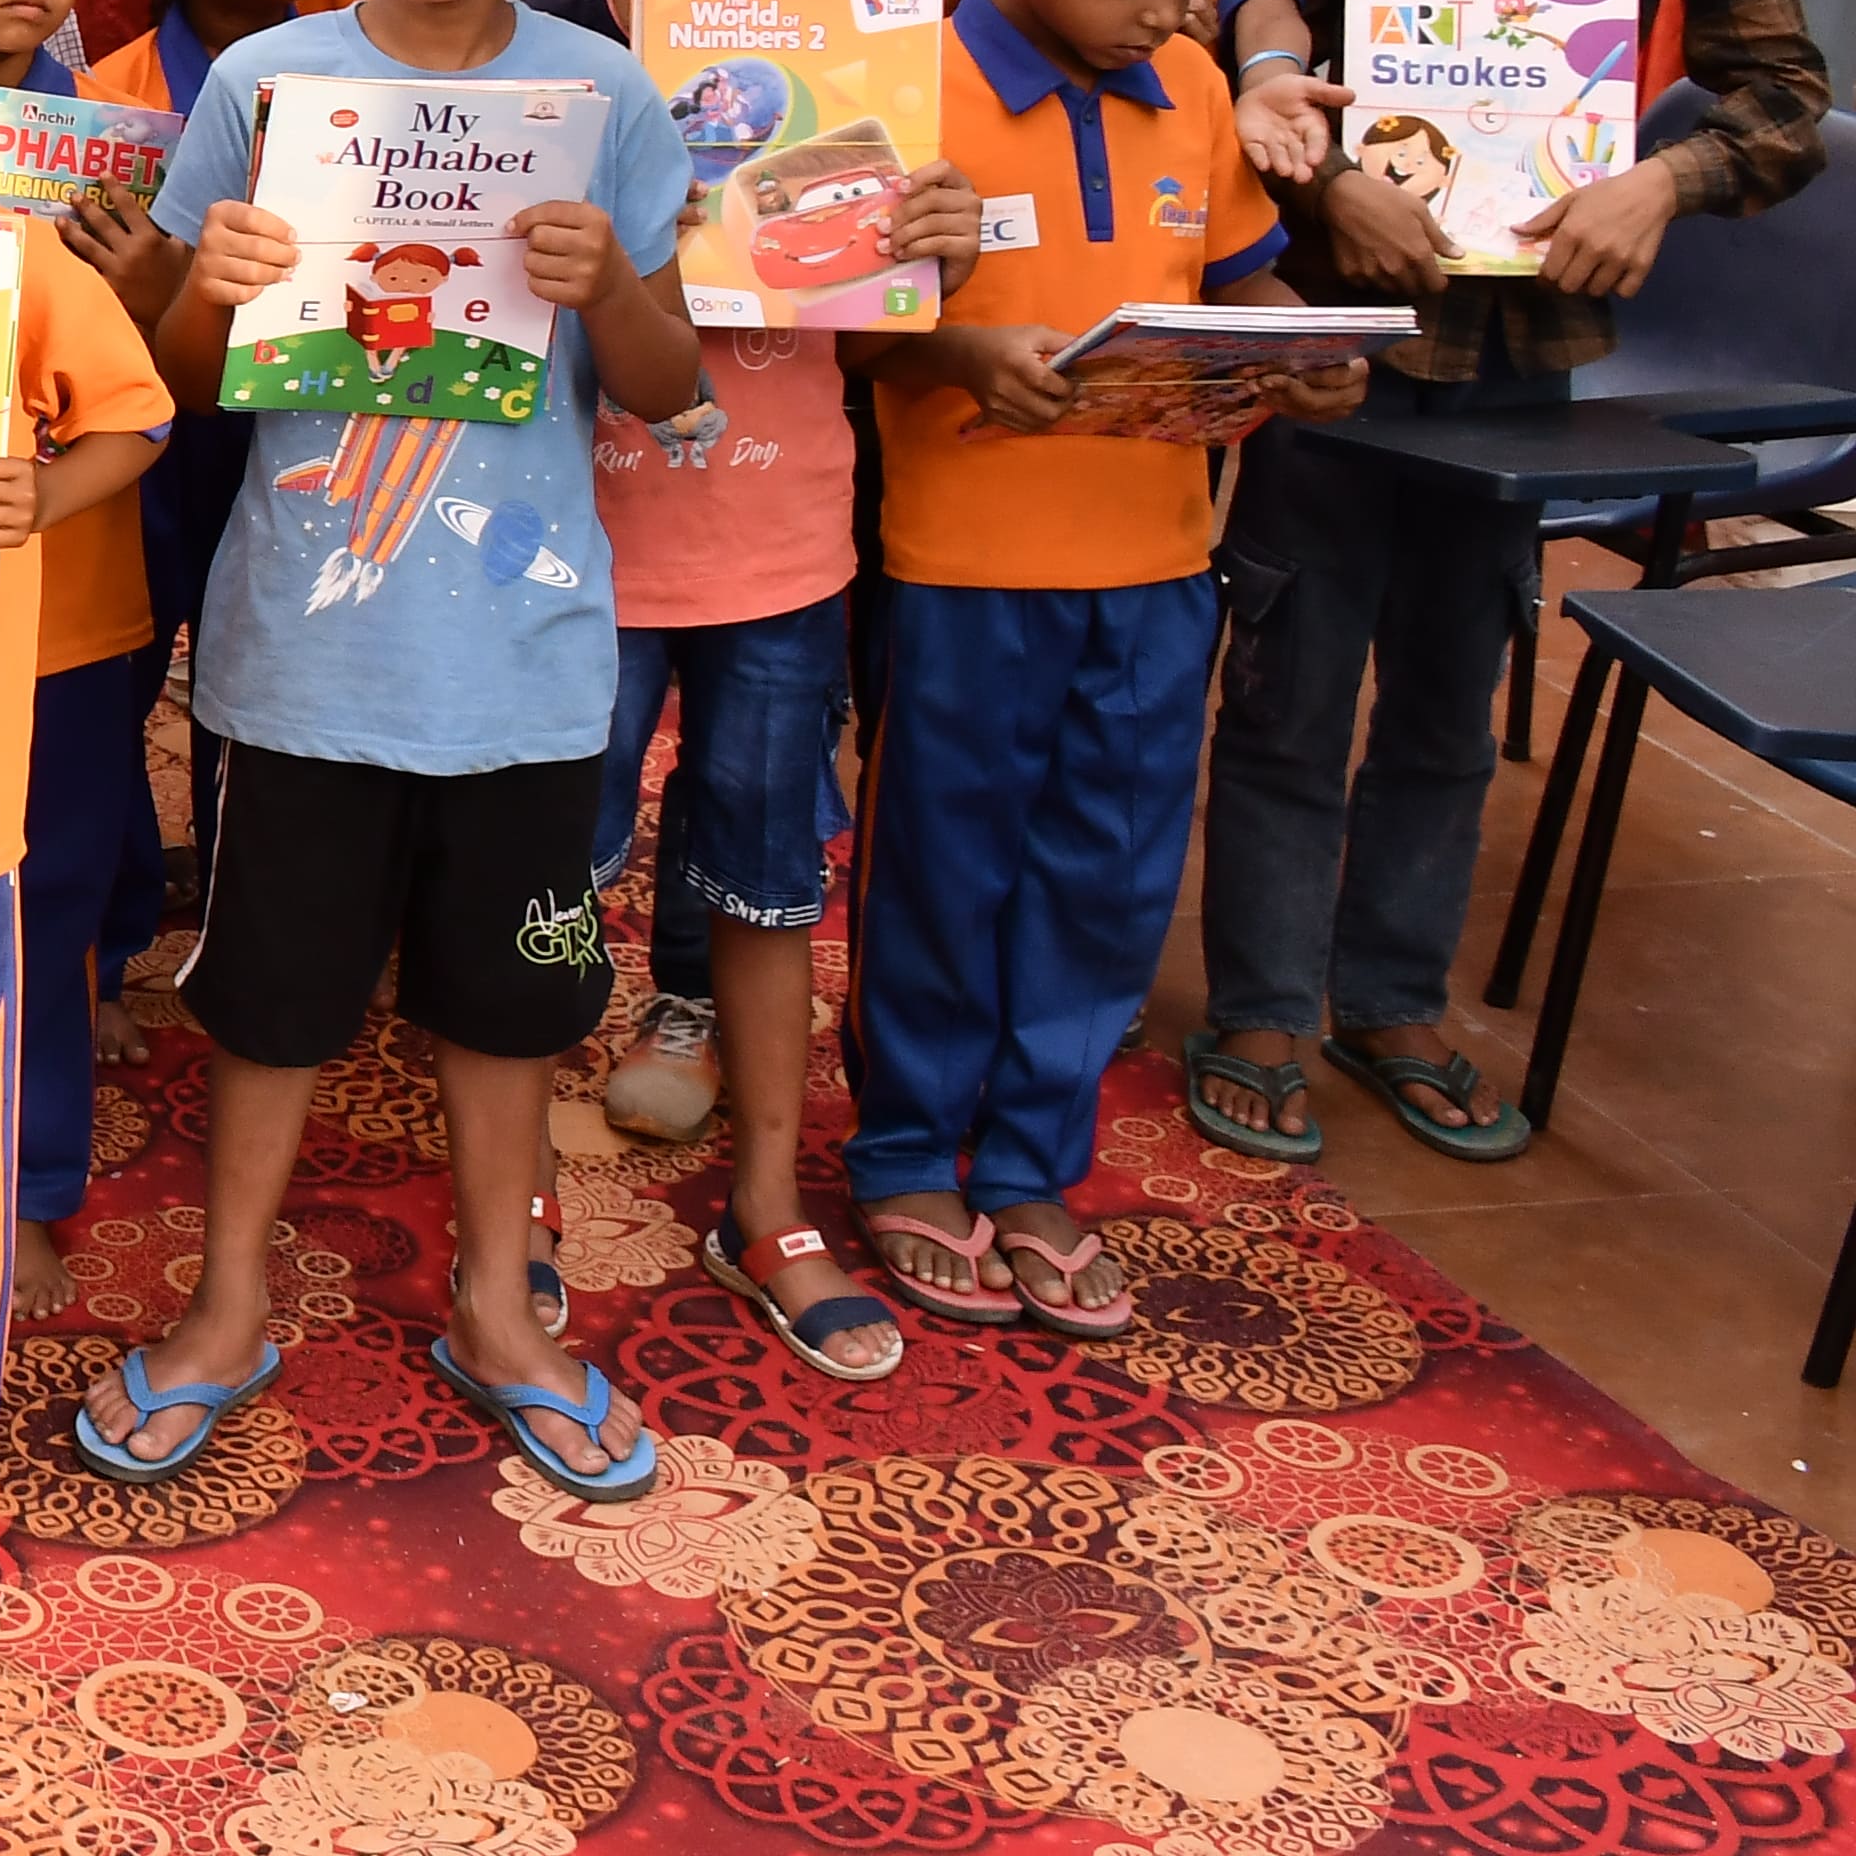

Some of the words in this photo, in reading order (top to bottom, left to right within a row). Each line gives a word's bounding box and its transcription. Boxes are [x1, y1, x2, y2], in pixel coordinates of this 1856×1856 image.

[690, 0, 779, 29] World
[1370, 0, 1474, 52] ART
[669, 23, 801, 50] Numbers
[808, 24, 826, 51] 2
[1371, 53, 1548, 90] Strokes
[408, 103, 481, 142] My
[335, 137, 538, 177] Alphabet
[371, 180, 484, 213] Book
[425, 217, 457, 228] Small
[458, 217, 495, 229] letters
[980, 219, 1016, 243] EC
[298, 300, 322, 322] E
[464, 298, 492, 323] e
[691, 296, 743, 313] Osmo
[480, 343, 513, 372] A
[299, 370, 329, 396] H
[406, 375, 436, 405] d
[594, 441, 644, 473] Run
[722, 892, 784, 928] JEANS
